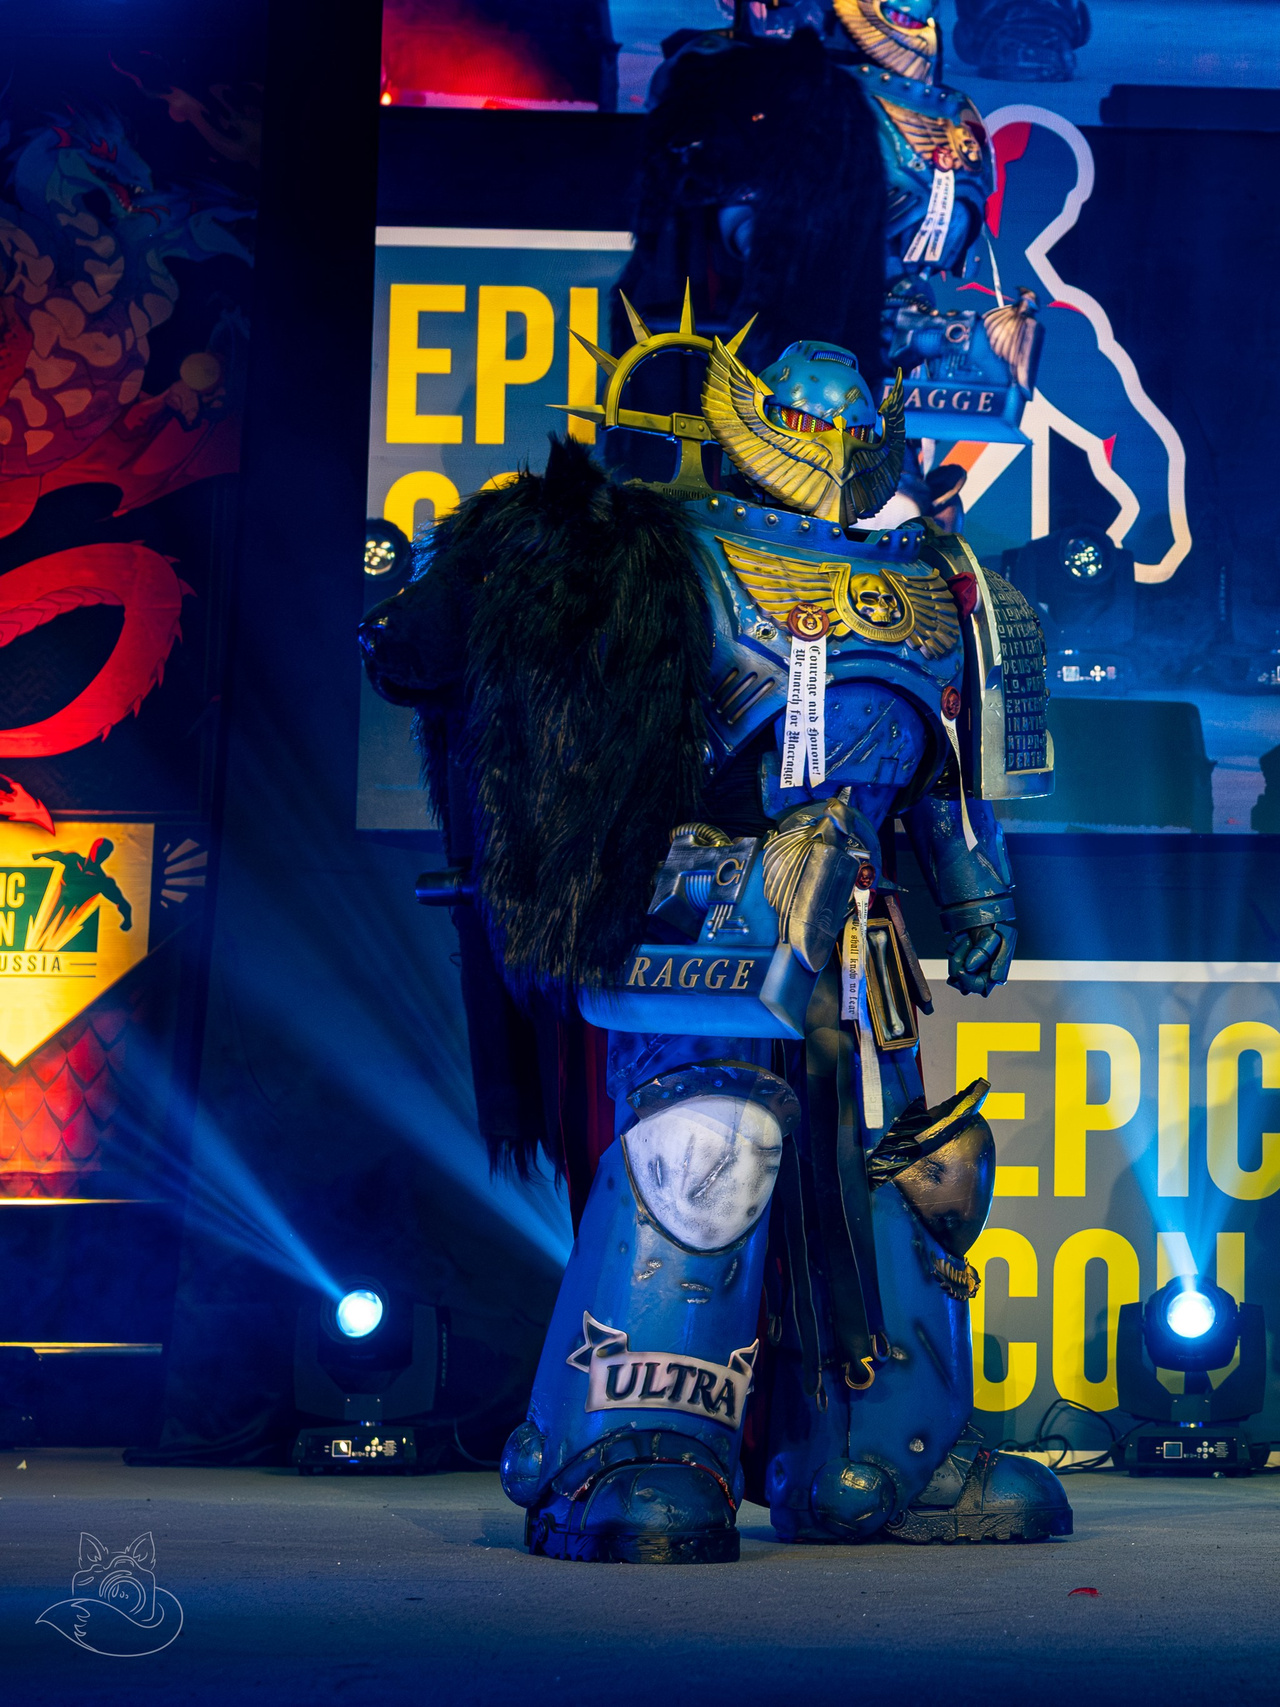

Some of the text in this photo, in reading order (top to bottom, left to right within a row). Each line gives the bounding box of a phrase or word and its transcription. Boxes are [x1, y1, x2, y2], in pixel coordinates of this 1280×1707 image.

[384, 282, 599, 446] EPI
[782, 649, 806, 786] We march for Macragge
[806, 645, 821, 776] Courage and Honour!
[849, 934, 859, 955] shall
[0, 955, 61, 972] USSIA
[626, 956, 756, 990] RAGGE
[848, 958, 859, 980] know
[849, 983, 858, 992] no
[848, 996, 858, 1015] fear
[605, 1361, 737, 1420] ULTRA
